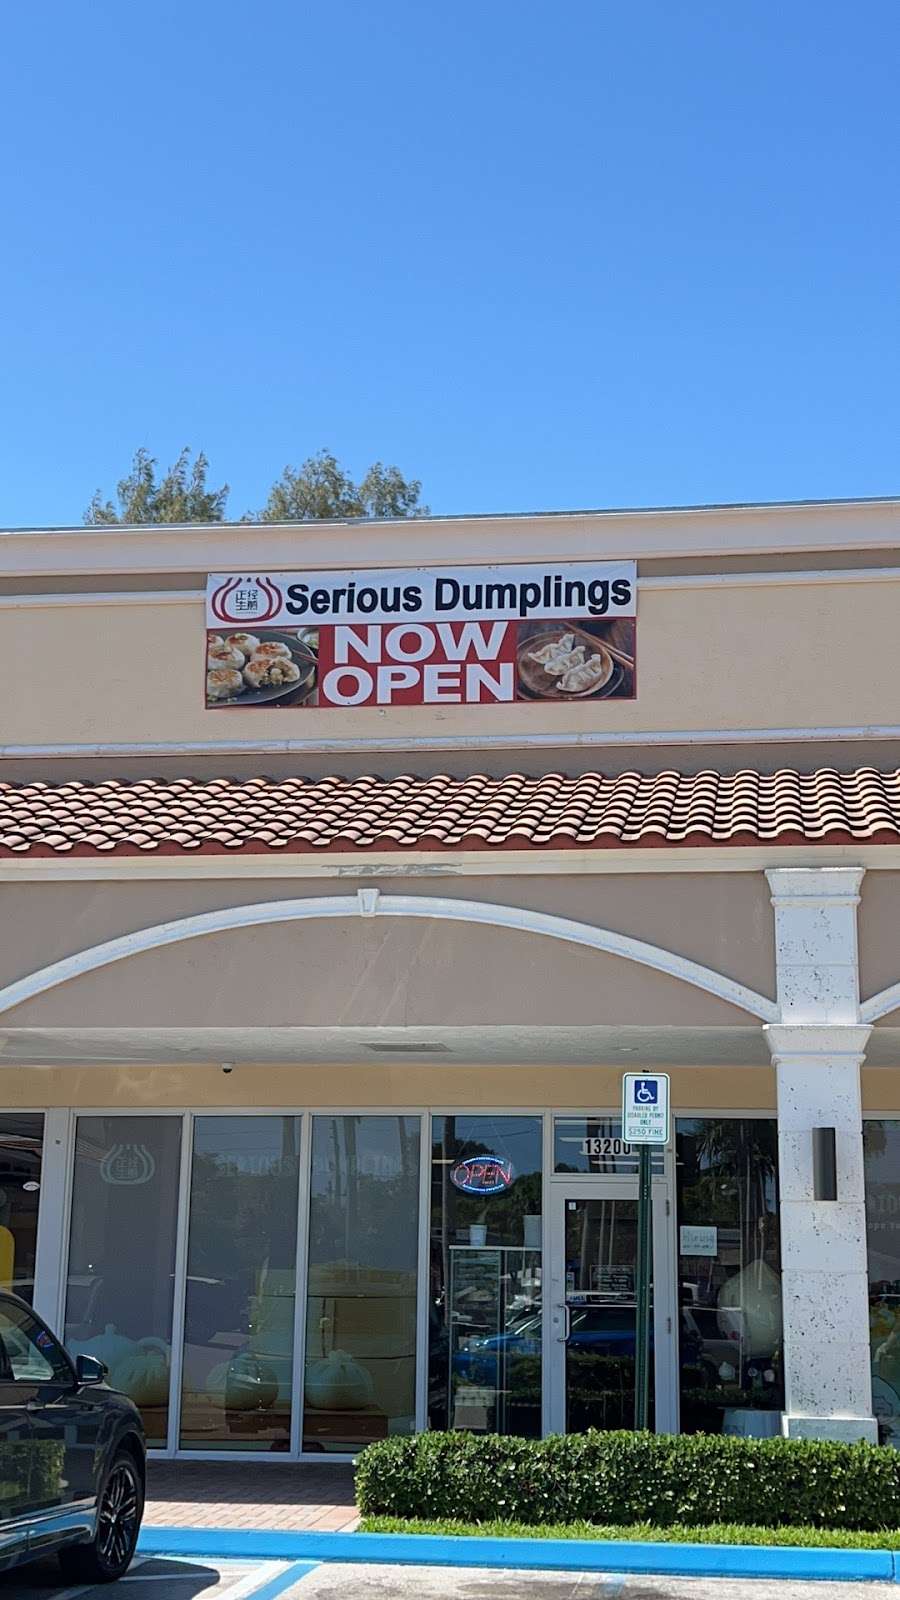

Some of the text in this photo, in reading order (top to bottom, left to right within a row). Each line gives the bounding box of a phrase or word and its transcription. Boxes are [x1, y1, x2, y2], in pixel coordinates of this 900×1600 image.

[286, 575, 631, 617] Serious Dumplings
[334, 622, 509, 664] NOW
[322, 662, 514, 705] OPEN
[585, 1139, 630, 1154] 13200
[453, 1162, 512, 1184] OPEN
